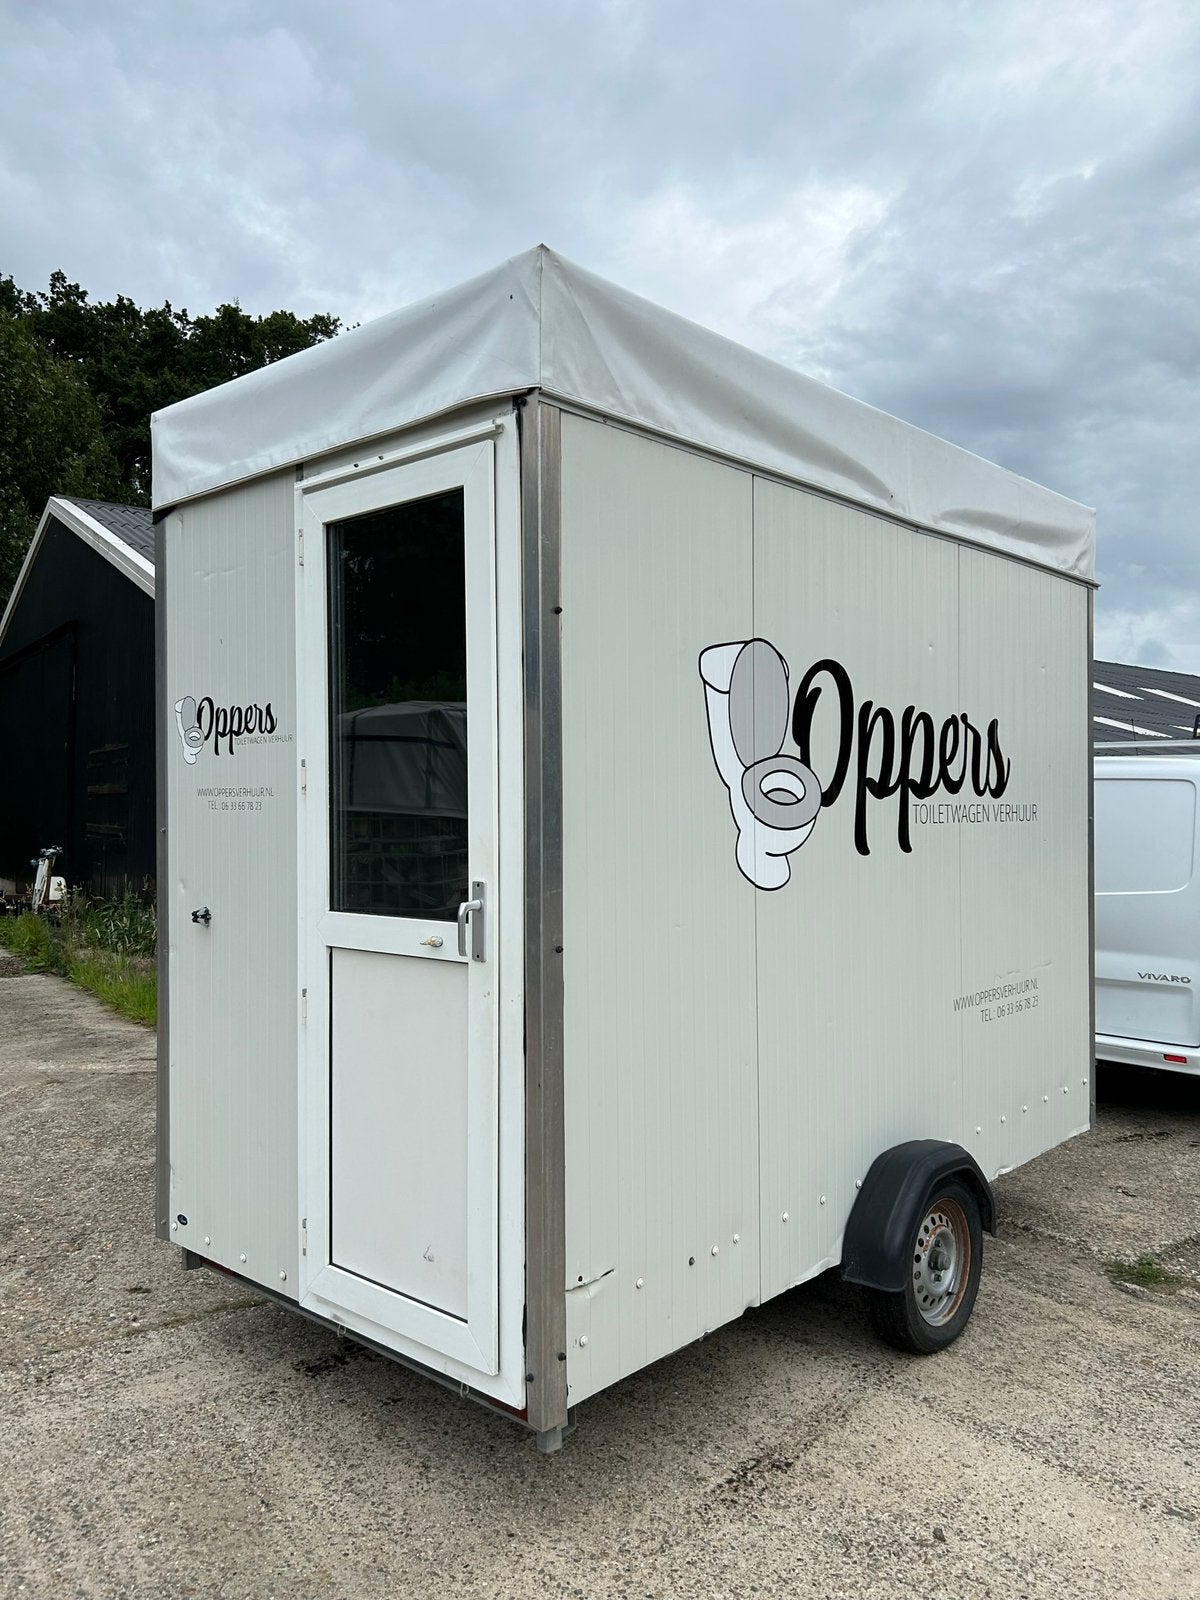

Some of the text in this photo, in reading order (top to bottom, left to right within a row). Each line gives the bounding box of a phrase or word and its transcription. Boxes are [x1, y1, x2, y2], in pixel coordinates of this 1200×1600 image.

[196, 696, 278, 756] Oppers
[268, 733, 293, 744] VERHUUR
[792, 659, 1010, 856] Oppers
[221, 801, 229, 811] 06
[230, 801, 237, 811] 33
[238, 801, 246, 811] 66
[246, 801, 254, 811] 78
[255, 801, 262, 811] 23
[912, 803, 1039, 825] TOILETWAGEN VERHUUR
[1137, 971, 1192, 984] VIVARO
[997, 1004, 1006, 1019] 06
[1006, 1002, 1014, 1016] 33
[1015, 1000, 1023, 1013] 66
[1024, 997, 1032, 1010] 78
[1032, 995, 1039, 1008] 23
